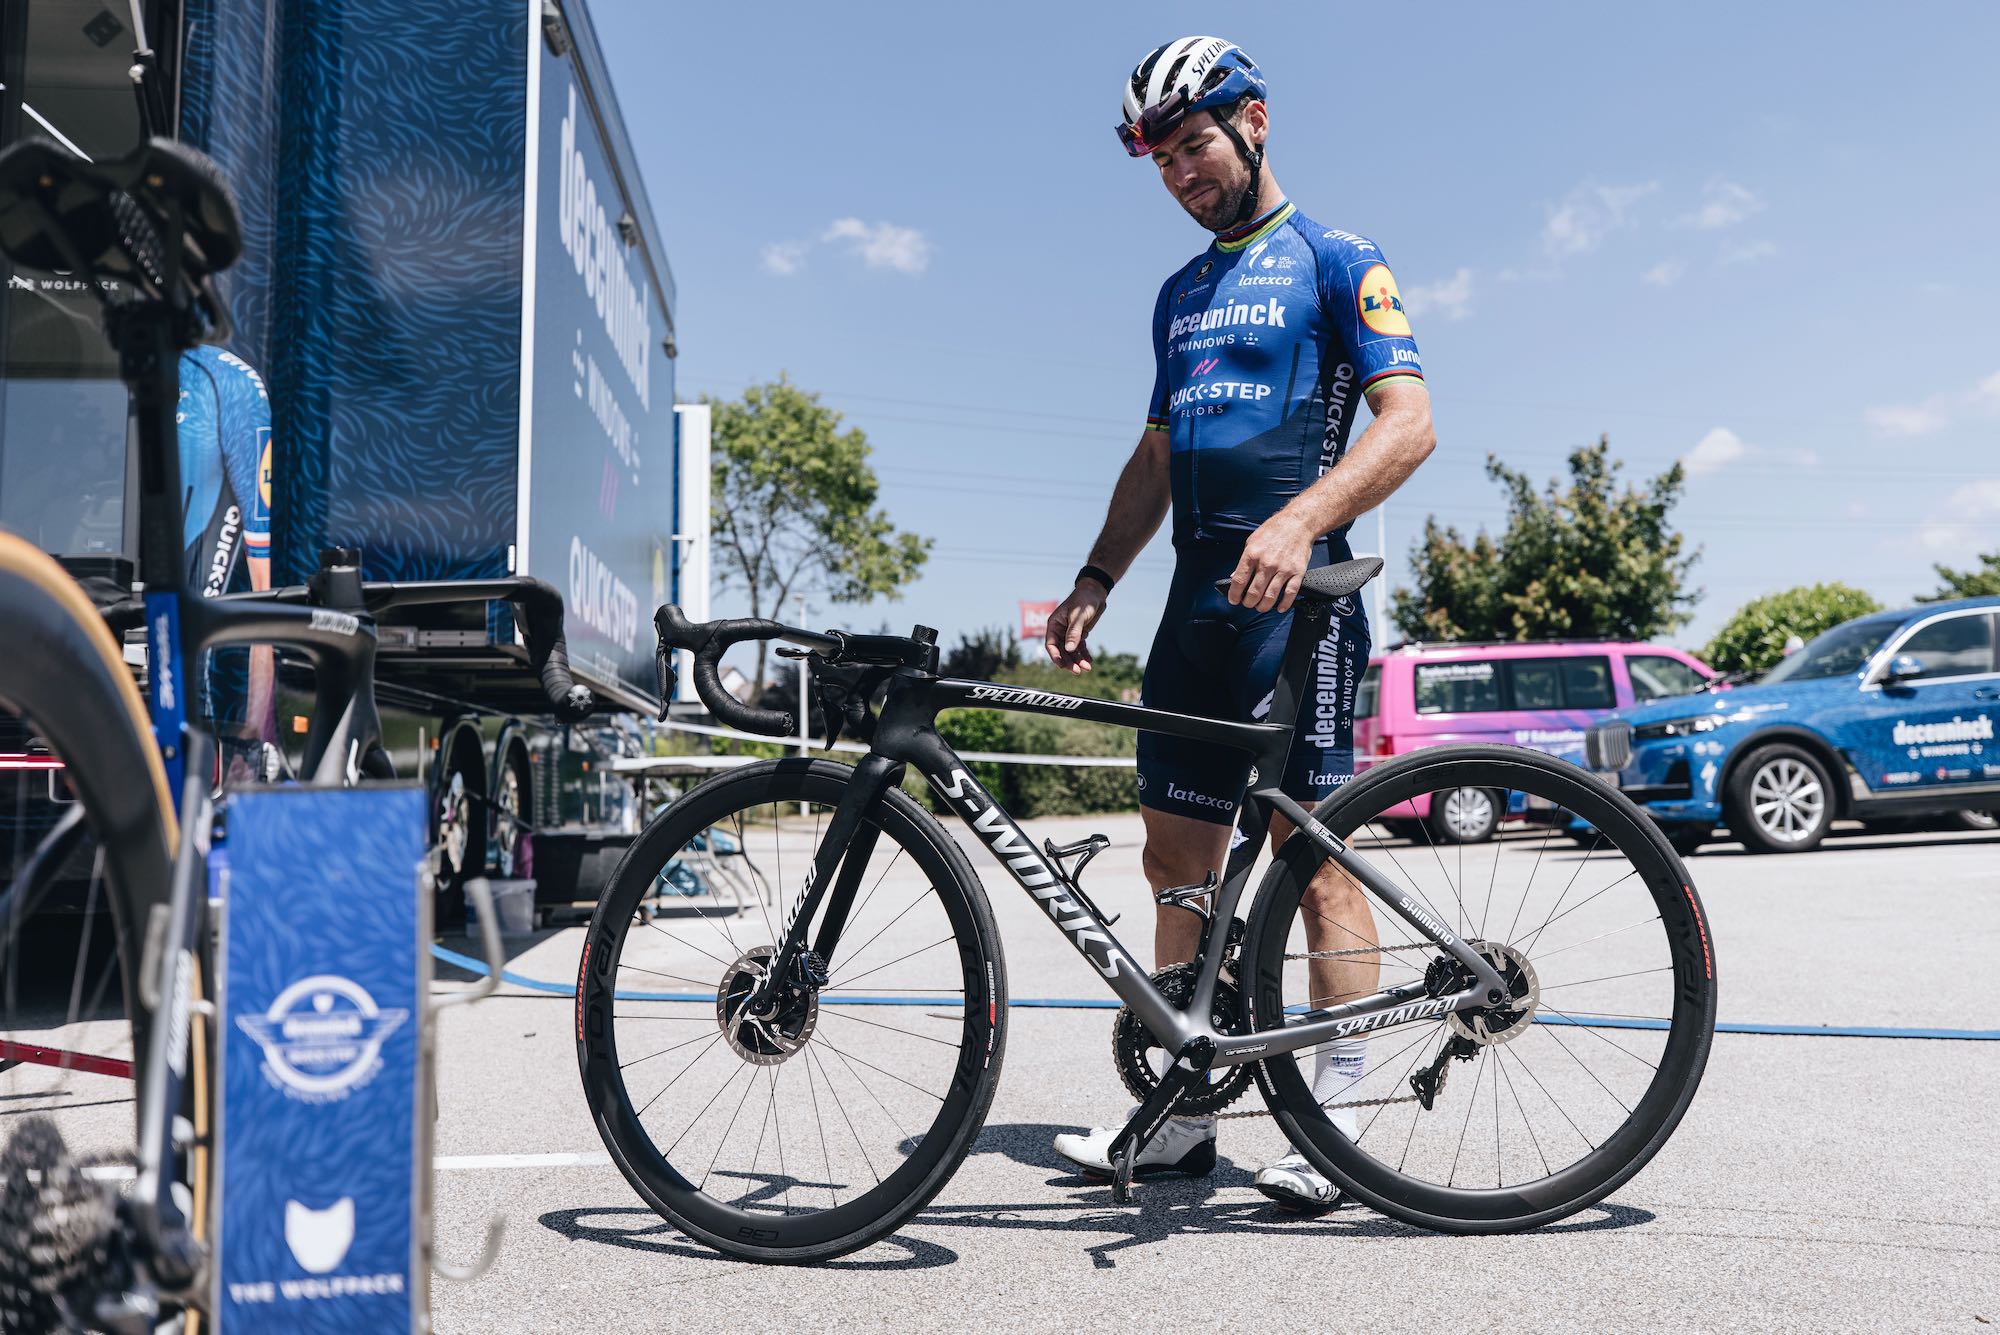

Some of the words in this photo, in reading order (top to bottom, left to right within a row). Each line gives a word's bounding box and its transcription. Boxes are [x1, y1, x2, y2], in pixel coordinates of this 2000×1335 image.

[41, 280, 119, 290] WOLFPCK
[1238, 273, 1293, 286] latexco
[965, 686, 1084, 710] SPECIALIZED
[1167, 782, 1234, 810] latexco
[931, 769, 1137, 978] S-WORKS
[761, 860, 817, 990] SPECIALIZED
[1399, 896, 1455, 946] SHIMANO
[1683, 884, 1712, 980] SPECIALIZED
[577, 942, 591, 1041] SPECIALIZED
[1330, 996, 1460, 1040] SPECIALIZED
